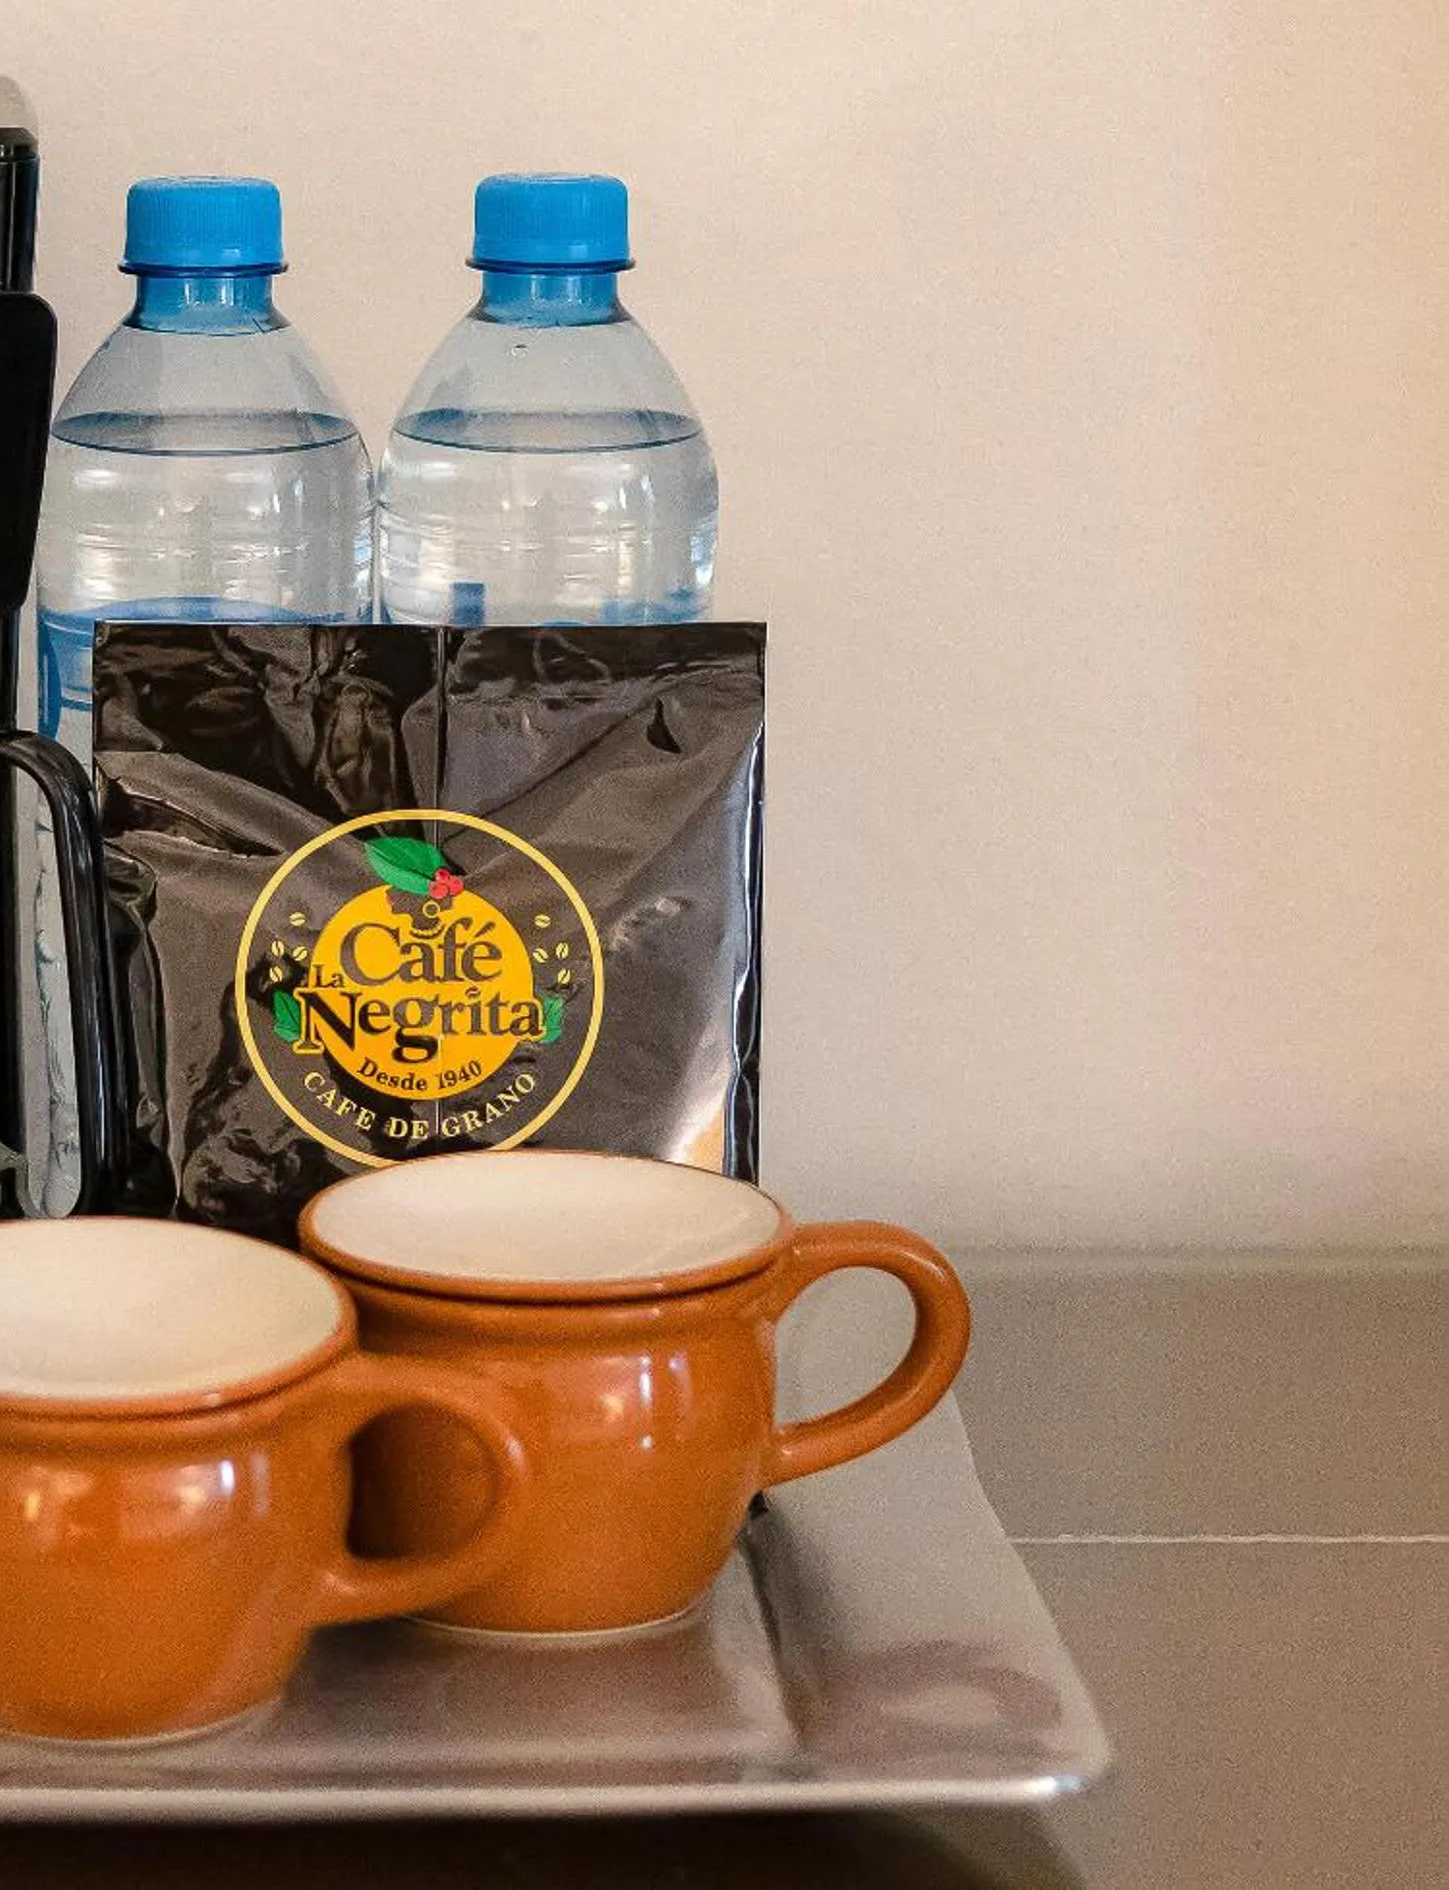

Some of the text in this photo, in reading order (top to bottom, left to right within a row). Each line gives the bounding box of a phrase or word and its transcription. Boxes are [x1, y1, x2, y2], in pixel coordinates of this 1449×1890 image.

[312, 963, 346, 989] La
[339, 917, 502, 988] Café
[294, 987, 544, 1064] Negrita
[302, 1070, 536, 1140] CAFE DE GRANO
[356, 1055, 483, 1092] Desde 1940
